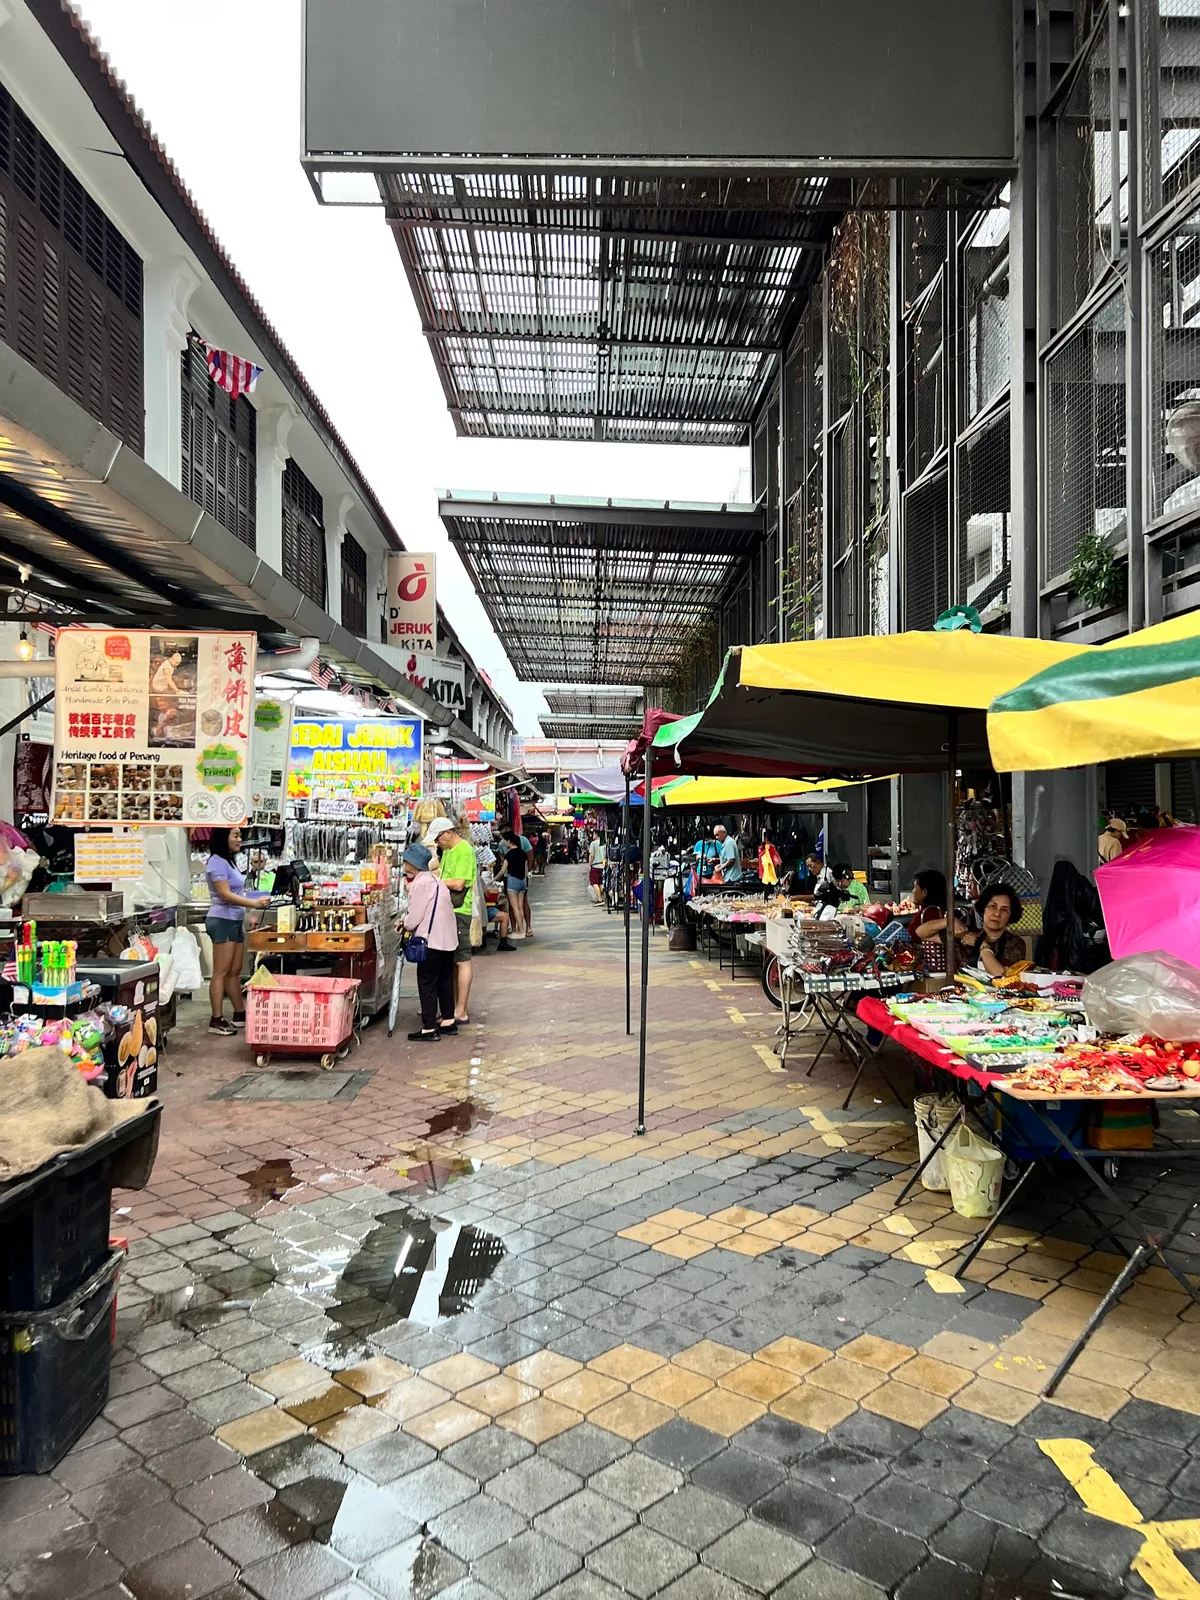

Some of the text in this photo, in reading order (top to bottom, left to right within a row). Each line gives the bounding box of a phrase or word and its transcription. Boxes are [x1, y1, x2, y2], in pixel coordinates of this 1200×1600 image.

[390, 623, 433, 635] JERUK
[65, 695, 104, 704] Handmade
[348, 724, 414, 747] JERUK
[61, 750, 160, 762] Heritage food of Penang
[313, 750, 387, 774] AISHAH
[204, 767, 236, 777] Friendly
